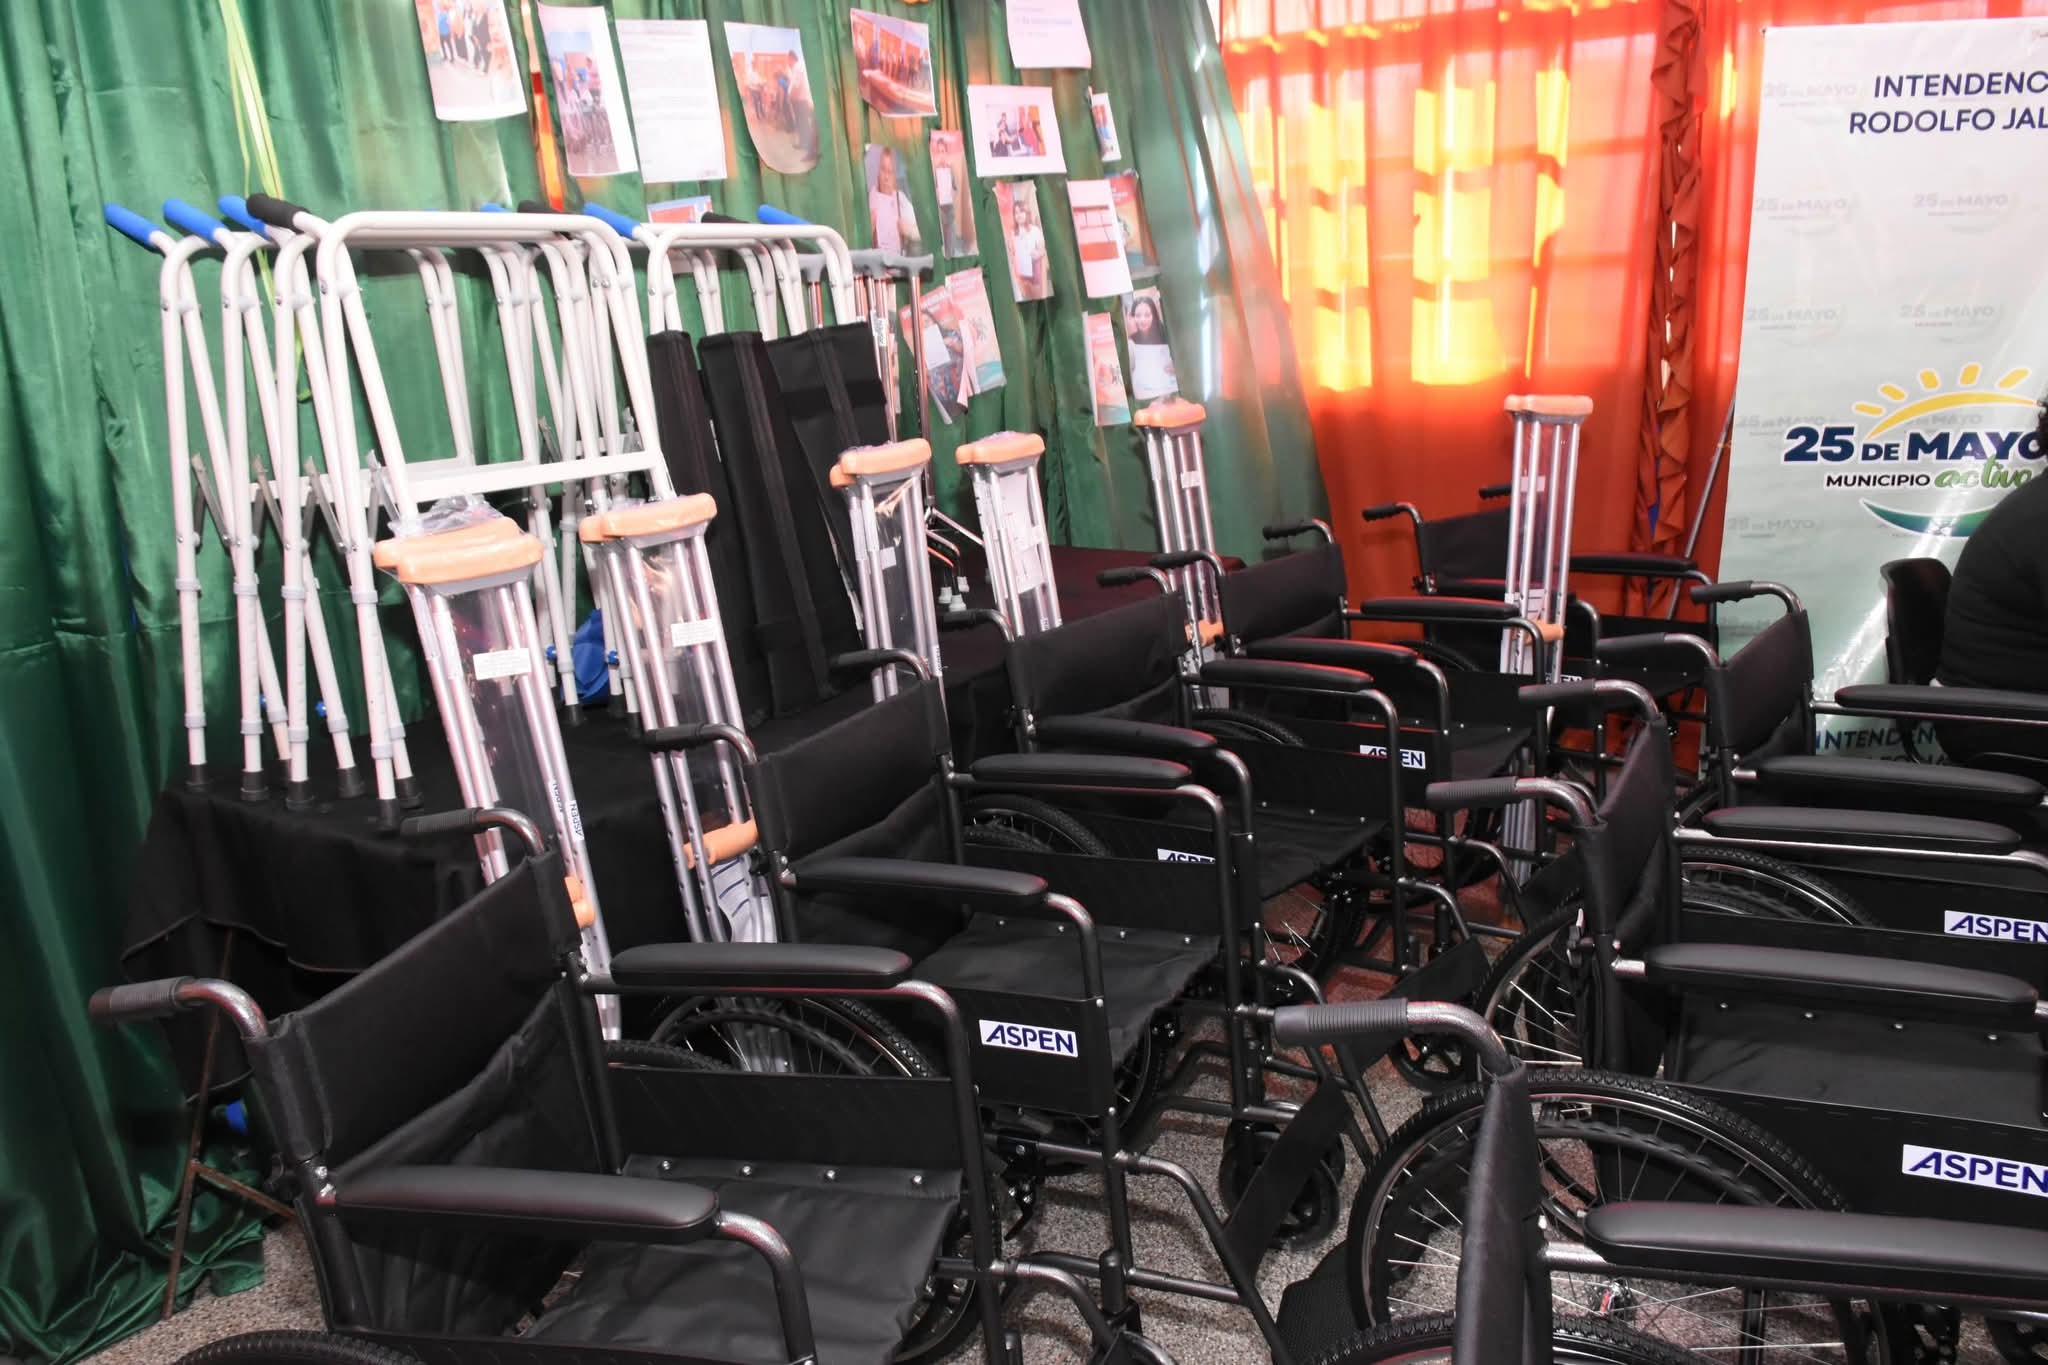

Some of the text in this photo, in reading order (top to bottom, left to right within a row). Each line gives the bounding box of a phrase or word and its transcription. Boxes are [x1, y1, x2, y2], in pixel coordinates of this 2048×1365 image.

[1849, 108, 1996, 134] RODOLFO
[1784, 426, 2044, 462] 25 DE MAYO
[1826, 474, 1931, 488] MUNICIPIO
[1949, 914, 2048, 944] ASPEN
[986, 1024, 1074, 1054] ASPEN
[1909, 1151, 2048, 1193] ASPEN
